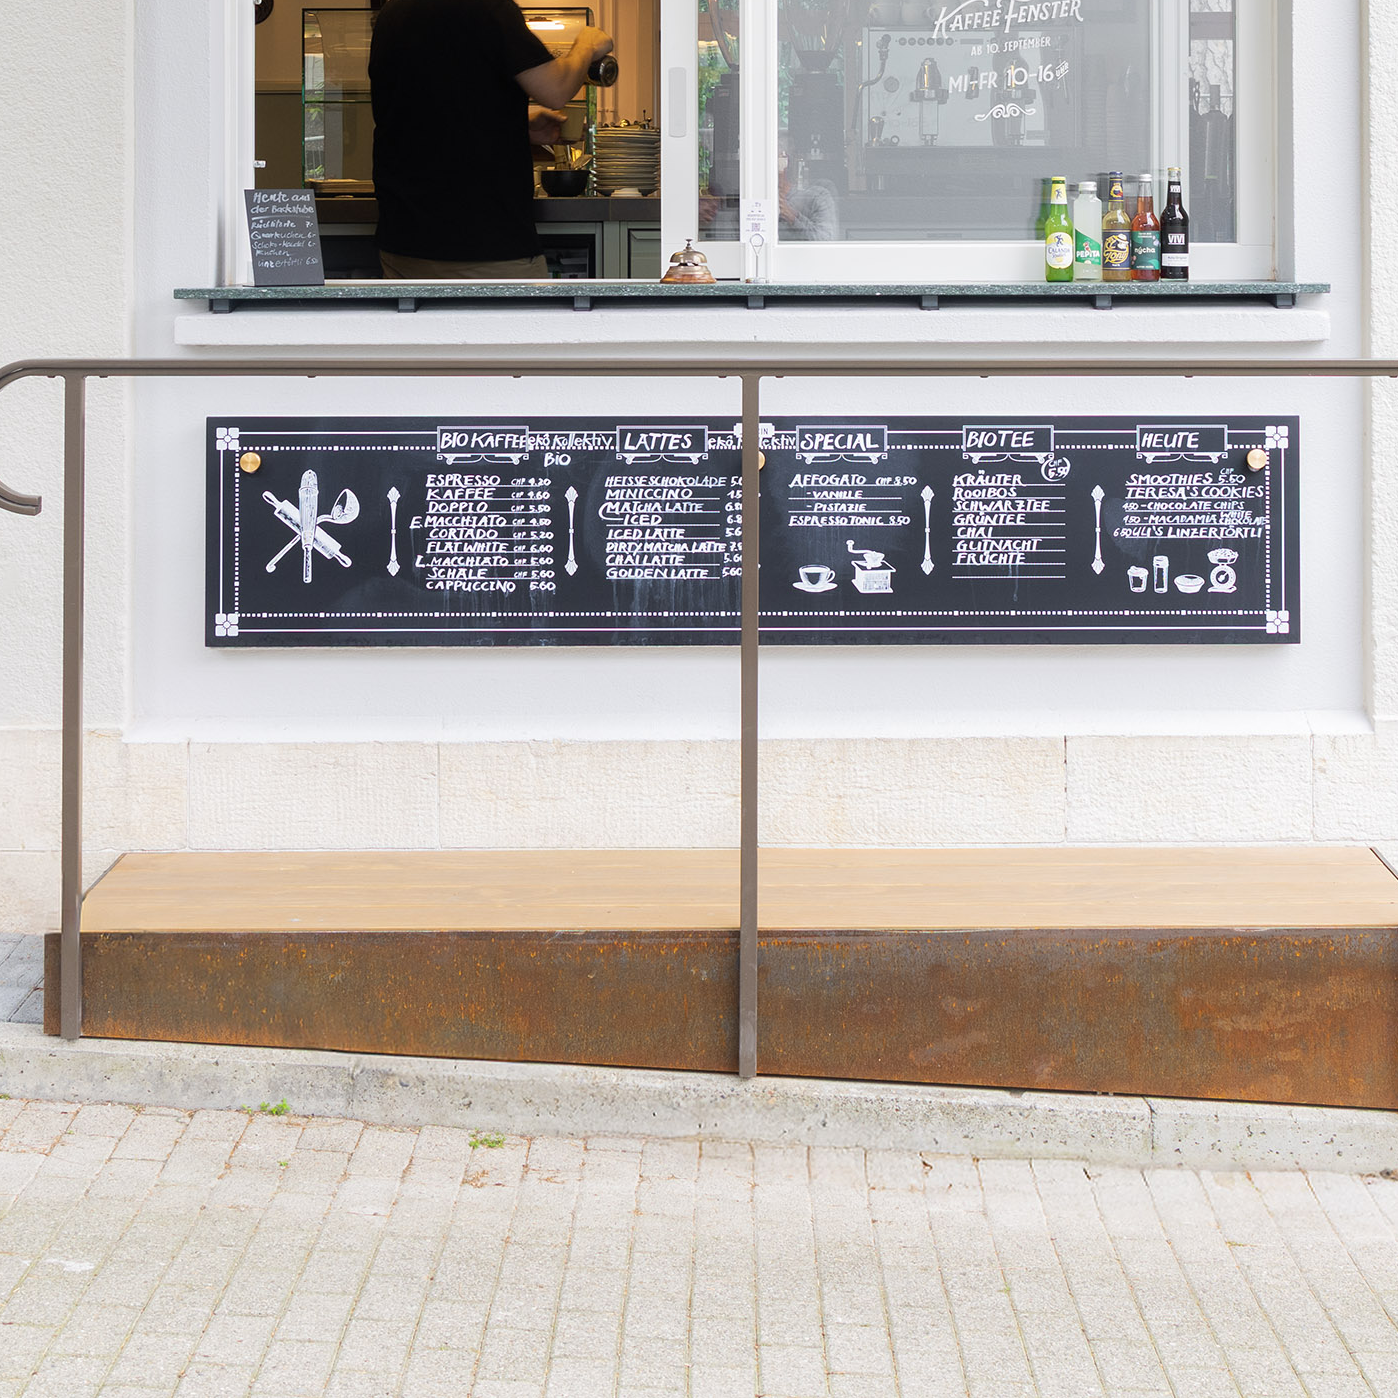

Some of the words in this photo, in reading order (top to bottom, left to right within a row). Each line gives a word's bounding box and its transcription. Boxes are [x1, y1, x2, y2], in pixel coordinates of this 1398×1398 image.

[971, 45, 983, 56] AB
[1003, 36, 1051, 52] SEPTEMBER
[1055, 63, 1069, 77] UHR
[253, 192, 289, 203] Heute
[292, 194, 311, 202] aus
[251, 205, 269, 214] der
[271, 204, 314, 214] Backstube
[1168, 233, 1185, 245] VIVI
[1076, 250, 1100, 258] PEPITA
[441, 432, 468, 449] BIO
[471, 433, 527, 449] KAFFEE
[624, 433, 692, 451] LATTES
[800, 433, 879, 451] SPECIAL
[1141, 432, 1200, 448] HEUTE
[426, 474, 501, 487] ESPRESSO
[789, 473, 866, 488] AFFOGATO
[952, 470, 1027, 487] KRÄUTER
[1126, 473, 1213, 485] SMOOTHIES
[1218, 474, 1245, 484] 5.50
[426, 488, 496, 500] KAFFEE
[605, 489, 693, 500] MINICCINO
[953, 487, 1017, 500] ROOIBOS
[1126, 486, 1199, 499] TERESA'S
[1201, 486, 1264, 498] COOKIES
[428, 502, 488, 513] DOPPIO
[606, 502, 661, 514] MATCHA
[665, 502, 704, 513] LATTE
[954, 499, 1050, 512] SCHWARZTEE
[624, 514, 662, 526] ICED
[954, 511, 1026, 526] GRÜNTEE
[429, 528, 498, 540] CORTADO
[607, 529, 642, 540] ICED
[645, 528, 686, 540] LATTE
[957, 527, 993, 538] CHAI
[1167, 525, 1262, 539] LINZERTÖRTLI
[605, 542, 643, 556] DIRTY
[644, 542, 688, 553] MATCHA
[692, 541, 727, 553] LATTE
[605, 555, 639, 565] CHAI
[642, 555, 686, 566] LATTE
[956, 551, 1025, 565] FRÜCHTE
[428, 567, 488, 579] SCHALE
[606, 567, 669, 579] GOLDEN
[670, 569, 709, 580] LATTE
[426, 581, 516, 592] CAPPUCCINO
